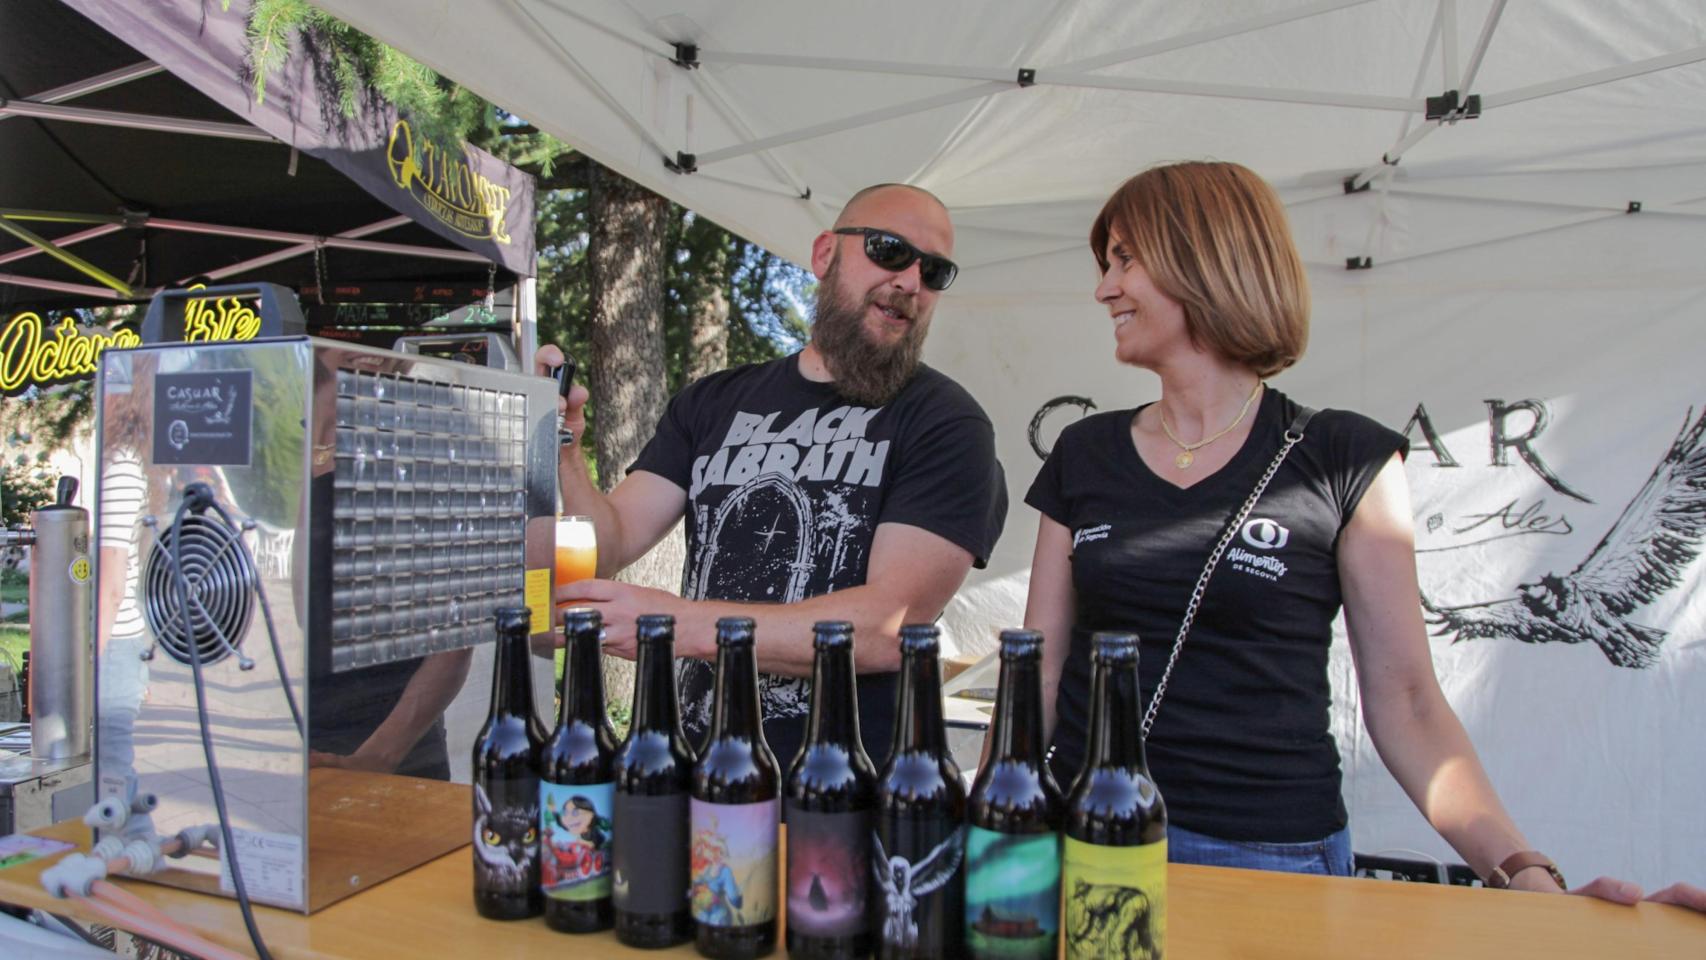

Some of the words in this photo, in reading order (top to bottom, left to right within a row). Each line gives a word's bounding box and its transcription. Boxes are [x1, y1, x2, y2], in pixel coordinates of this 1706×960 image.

[167, 385, 223, 402] CASUAR
[722, 405, 887, 448] BLACK
[689, 437, 890, 500] SABBATH
[1227, 547, 1289, 577] Alimentos
[1232, 563, 1244, 572] DE
[1244, 565, 1278, 582] SEGOVIA
